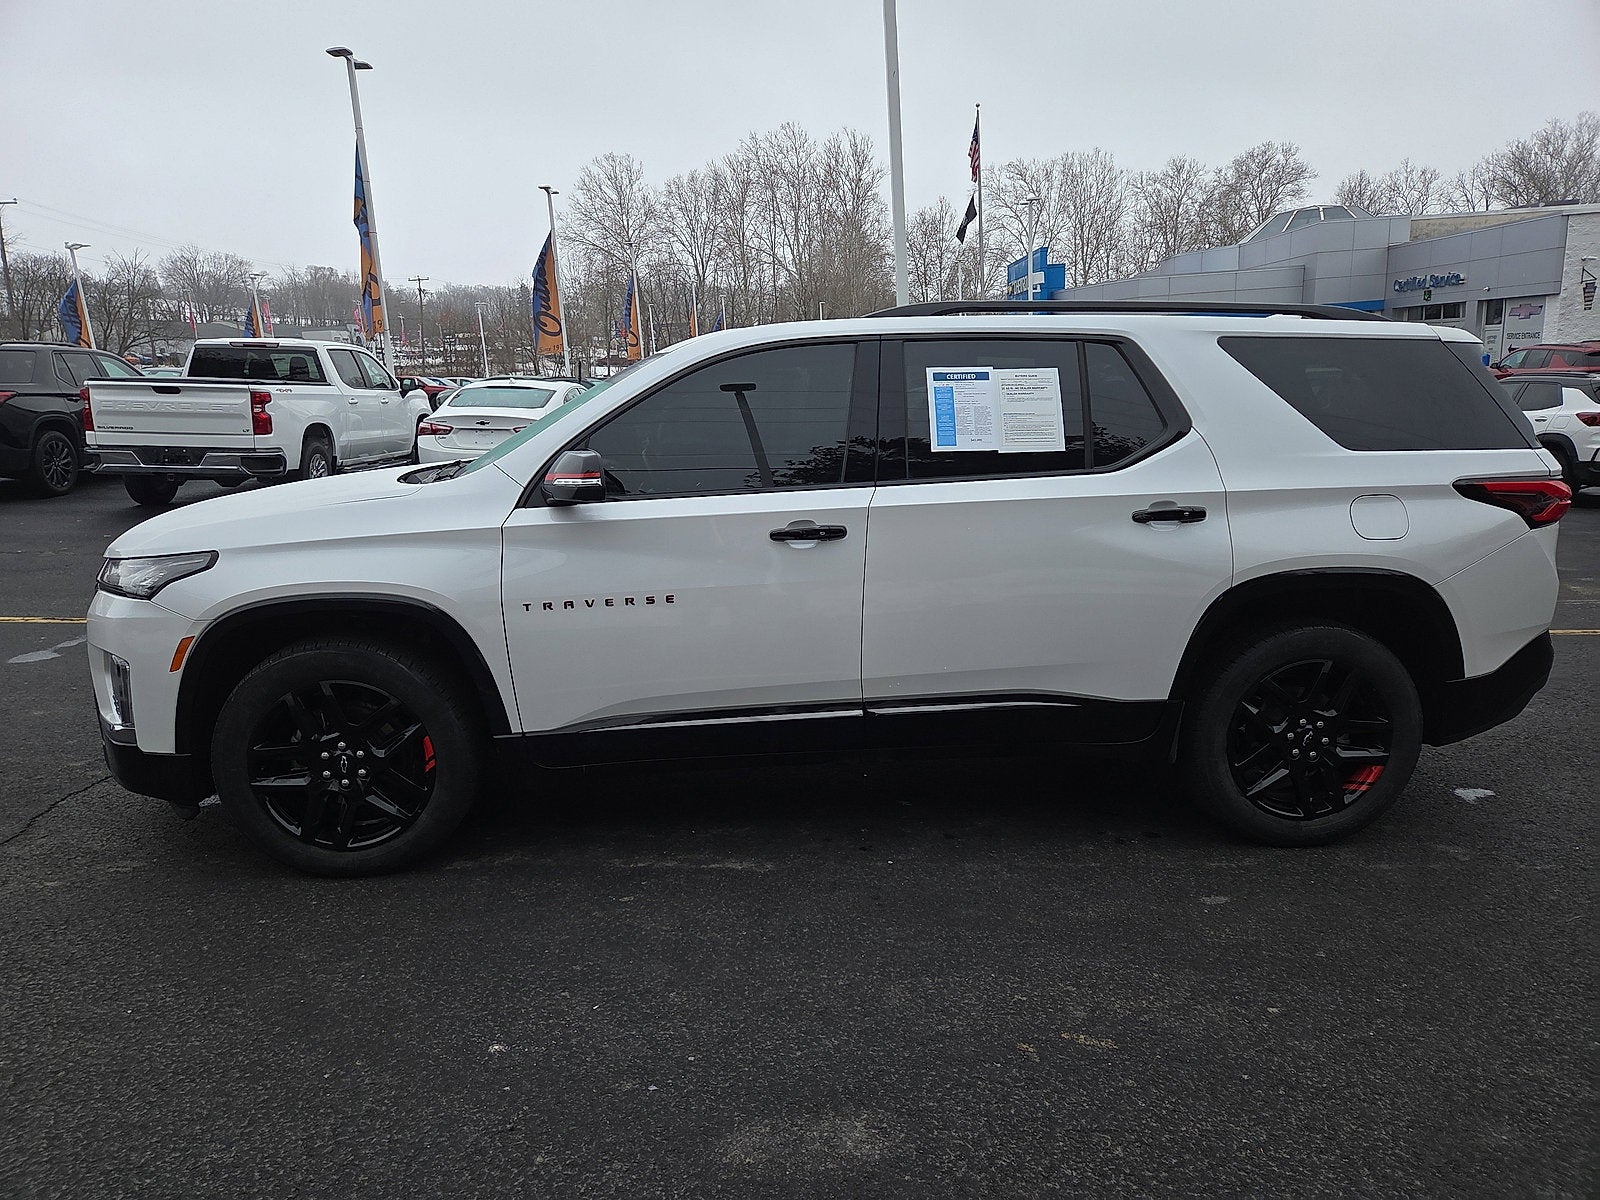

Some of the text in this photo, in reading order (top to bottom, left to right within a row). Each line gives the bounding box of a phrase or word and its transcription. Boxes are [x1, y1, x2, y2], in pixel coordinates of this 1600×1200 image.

[1429, 272, 1465, 289] Service
[1506, 332, 1521, 340] SERVICE
[1521, 331, 1541, 340] ENTRANCE
[100, 401, 240, 413] CHEVROLET
[522, 594, 676, 612] TRAVERSE
